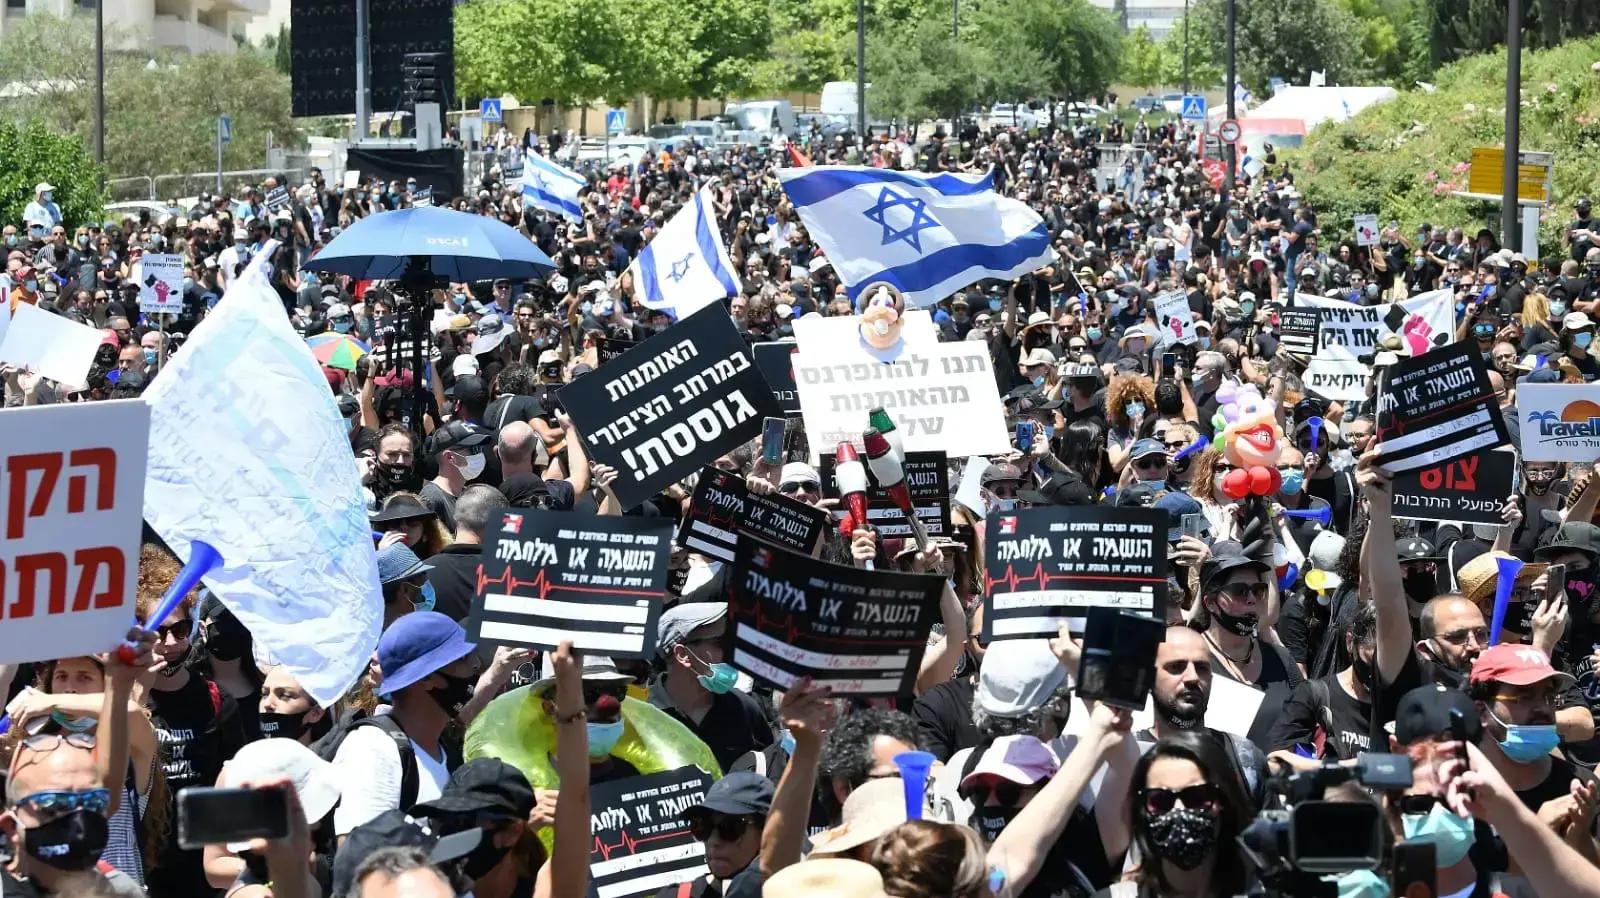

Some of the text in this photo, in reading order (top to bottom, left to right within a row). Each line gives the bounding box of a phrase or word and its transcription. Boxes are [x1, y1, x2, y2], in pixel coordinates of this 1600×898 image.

[1321, 328, 1379, 350] את הק
[605, 339, 698, 402] האומנות
[800, 354, 986, 384] תנו להתפרנס
[1312, 374, 1366, 390] זיקאים
[1425, 366, 1476, 396] הנשמה
[587, 352, 750, 445] במרחב הציבורי
[830, 385, 970, 412] מהאומנות
[1404, 385, 1420, 405] או
[620, 390, 758, 482] גוססת!
[898, 414, 944, 436] של
[1582, 439, 1600, 448] וולר
[907, 472, 938, 486] הנשמ
[1, 447, 117, 540] הק
[705, 488, 744, 512] מלחמה
[1394, 494, 1504, 512] לפועלי התרבות
[750, 506, 765, 521] או
[770, 512, 810, 539] הנשמה
[496, 538, 656, 572] הנשמה או מלחמה
[998, 534, 1152, 562] הנשמה או מלחמה
[0, 546, 125, 619] מת
[746, 570, 921, 624] הנשמה או מלחמה
[1342, 730, 1370, 749] נשמה
[591, 792, 705, 836] הנשמה או מלחמ
